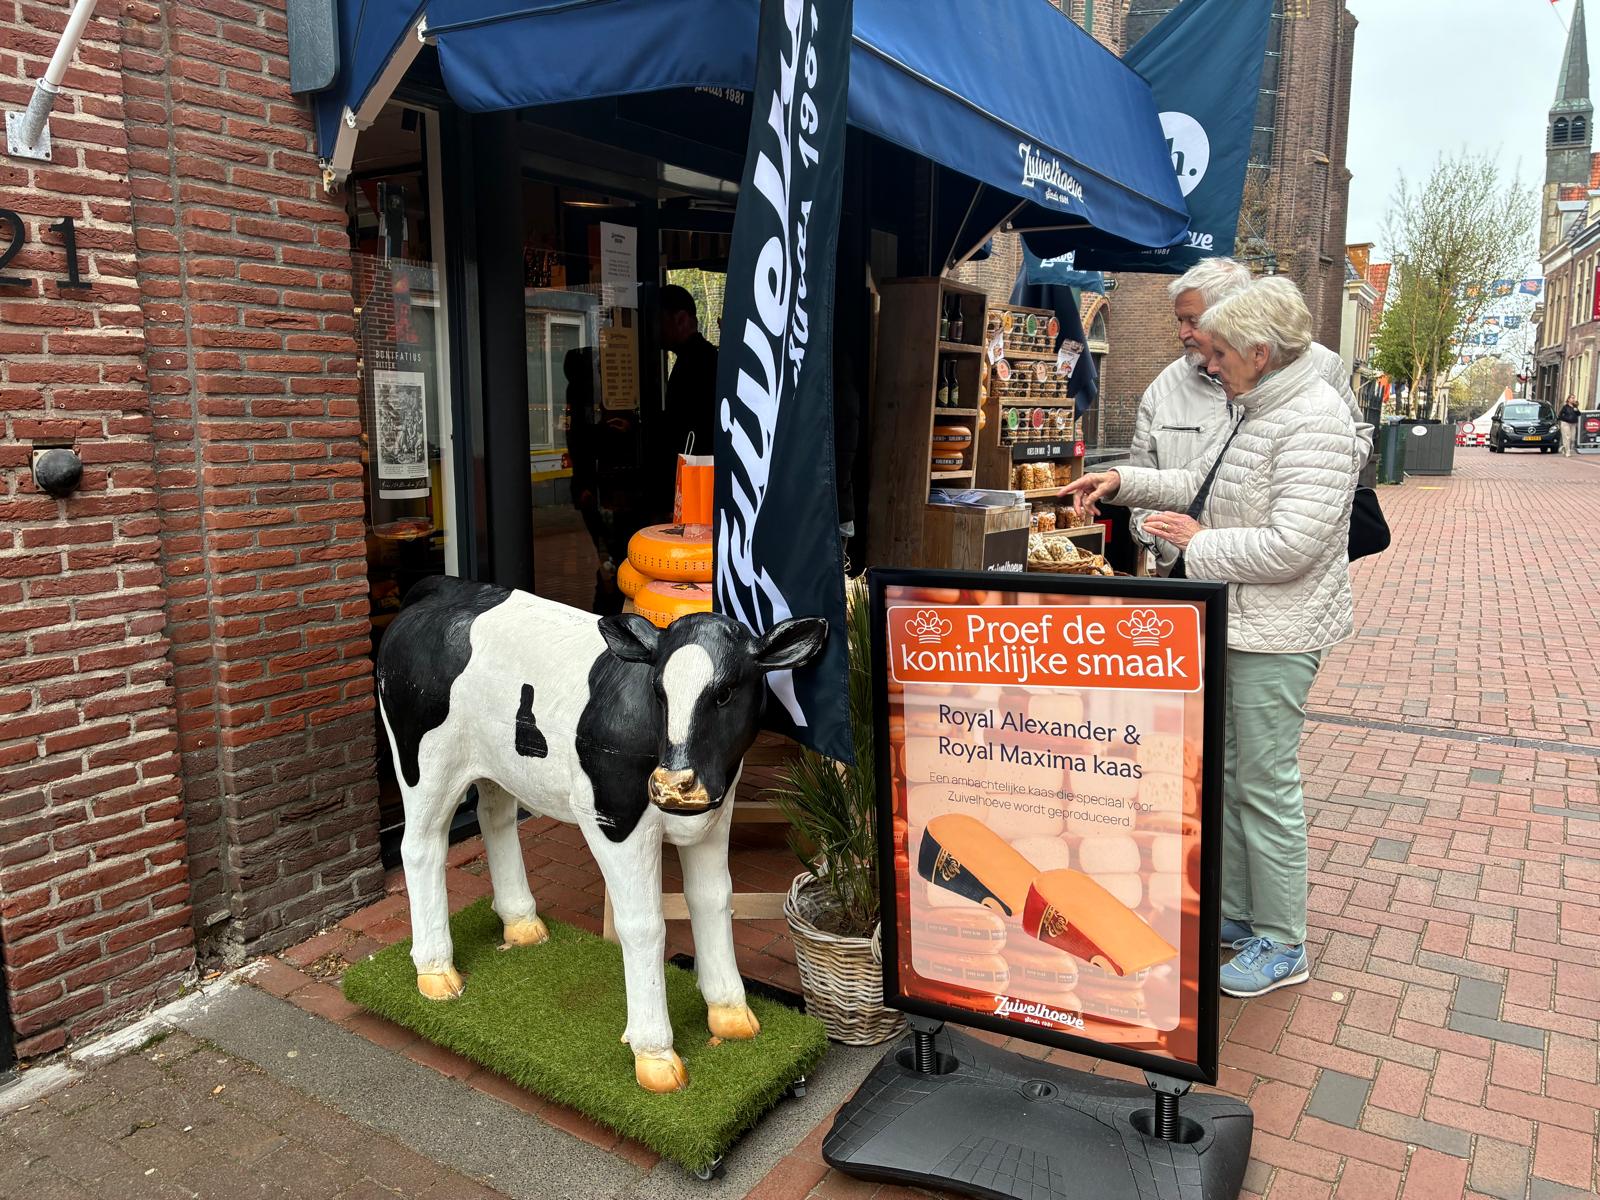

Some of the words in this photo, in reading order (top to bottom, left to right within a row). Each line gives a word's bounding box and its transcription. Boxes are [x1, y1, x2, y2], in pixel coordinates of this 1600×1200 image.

[725, 88, 745, 106] 1981
[1018, 142, 1084, 203] Zuivelhoeve
[375, 350, 422, 362] BONIFATIUS
[967, 613, 1053, 645] Proef
[1063, 614, 1106, 645] de
[901, 644, 1068, 682] koninklijke
[1077, 647, 1188, 678] smaak
[939, 703, 994, 732] Royal
[1000, 710, 1117, 743] Alexander
[1124, 725, 1141, 745] &
[939, 736, 993, 761] Royal
[1000, 744, 1086, 772] Maxima
[1093, 755, 1143, 779] kaas
[929, 772, 949, 784] Een
[951, 774, 1026, 796] ambachtelijke
[1028, 785, 1055, 798] kaas
[1056, 789, 1074, 802] die
[1076, 792, 1125, 809] speciaal
[1127, 801, 1153, 813] voor
[948, 790, 1012, 810] Zuivelhoeve
[1013, 801, 1046, 815] wordt
[1047, 807, 1133, 828] geproduceerd.
[993, 995, 1086, 1031] Zuivelhoeve
